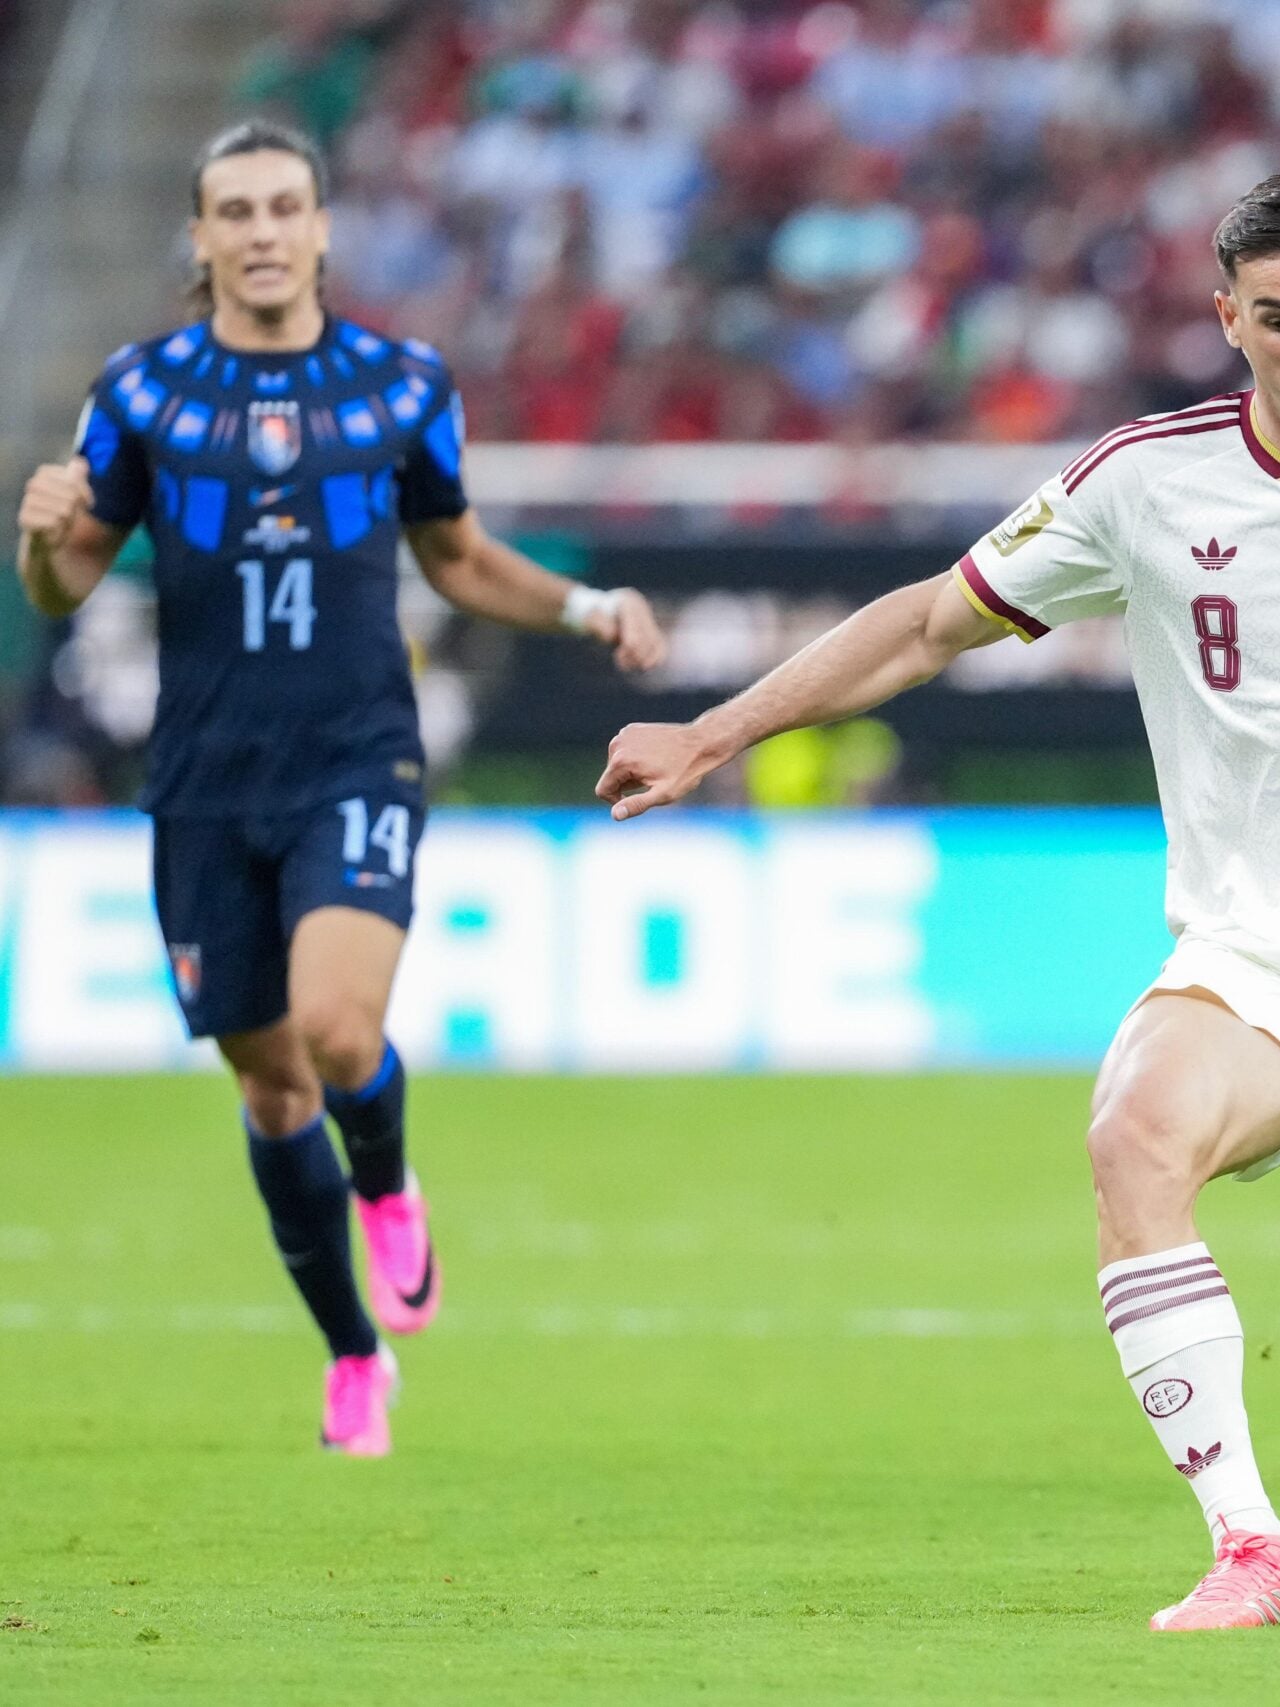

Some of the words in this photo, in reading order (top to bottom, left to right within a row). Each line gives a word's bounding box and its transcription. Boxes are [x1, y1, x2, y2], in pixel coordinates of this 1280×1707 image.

[235, 558, 318, 652] 14
[1191, 594, 1241, 692] 8
[336, 796, 411, 878] 14
[0, 815, 942, 1070] EADE
